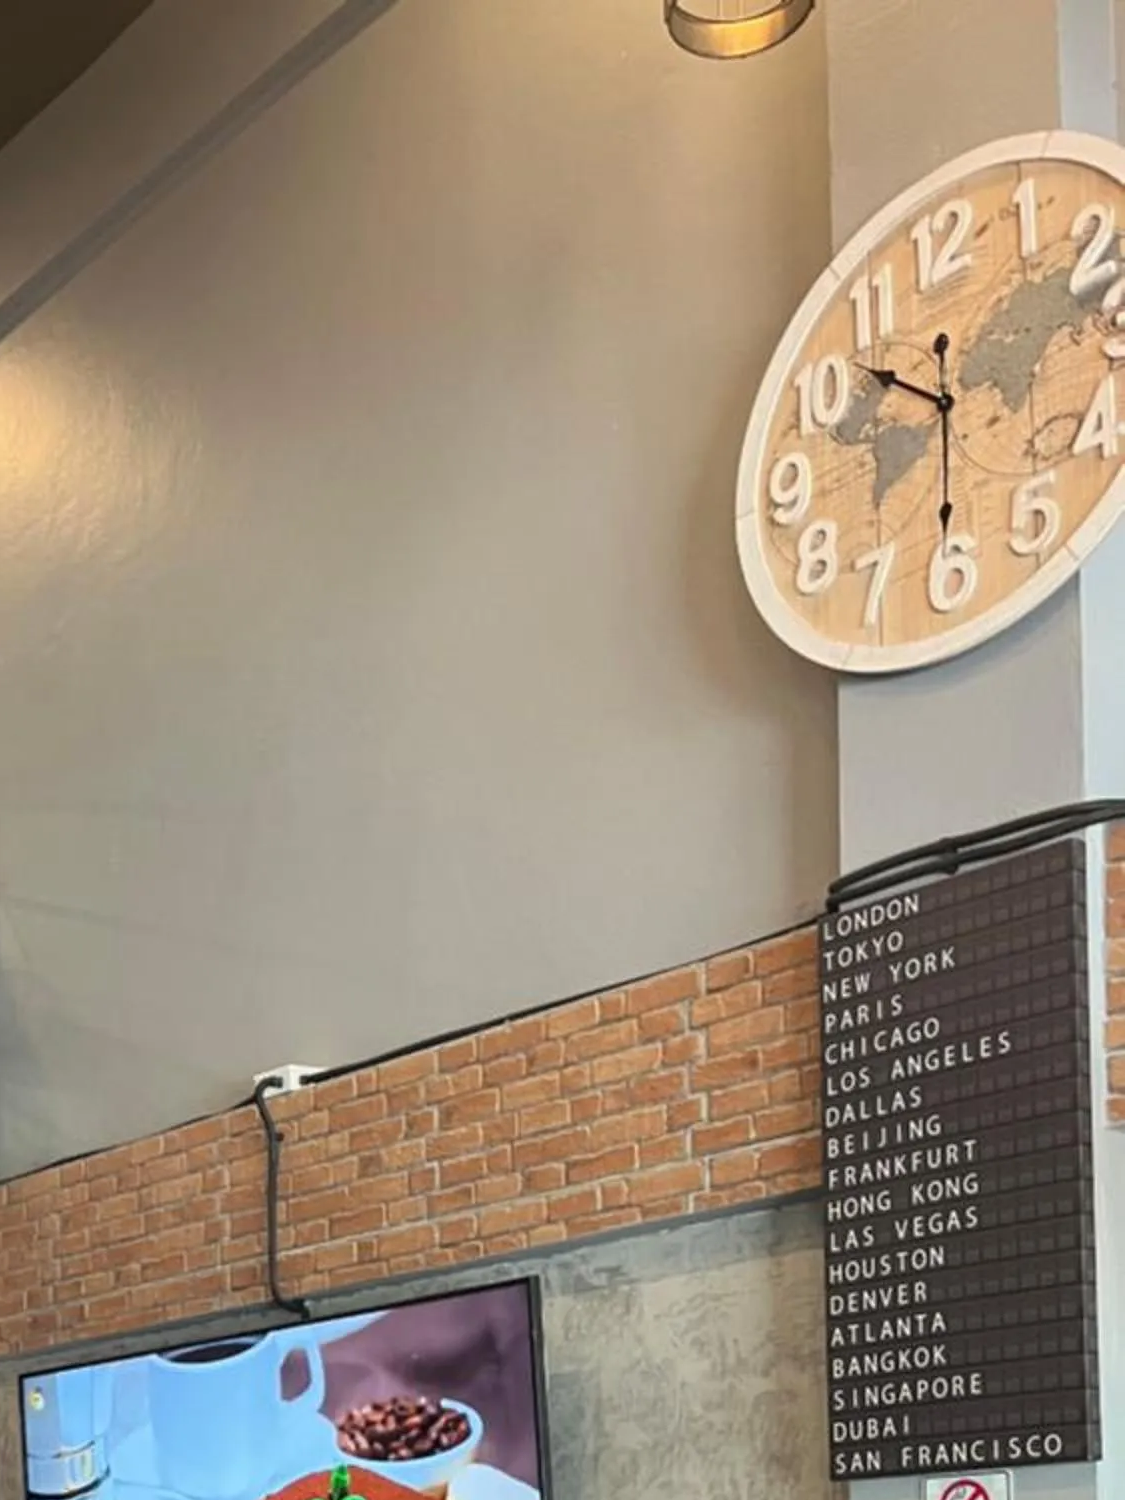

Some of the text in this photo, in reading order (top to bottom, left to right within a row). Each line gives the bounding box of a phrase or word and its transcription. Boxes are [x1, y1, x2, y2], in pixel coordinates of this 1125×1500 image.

[1012, 178, 1037, 258] 1
[911, 198, 974, 293] 12
[1069, 203, 1118, 295] 2
[850, 262, 893, 351] 11
[794, 354, 849, 437] 10
[1073, 374, 1125, 460] 4
[770, 452, 813, 527] 9
[1008, 470, 1061, 557] 5
[796, 518, 838, 595] 8
[928, 533, 979, 614] 6
[852, 541, 895, 629] 7
[824, 894, 920, 941] LONDON
[824, 931, 903, 971] TOKYO
[824, 946, 956, 1003] NEW YORK
[825, 994, 903, 1034] PARIS
[825, 1017, 940, 1065] CHICAGO
[827, 1031, 1011, 1097] LOS ANGELES
[825, 1087, 922, 1128] DALLAS
[827, 1114, 942, 1159] BEIJING
[828, 1140, 977, 1191] FRANKFURT
[827, 1173, 979, 1222] HONG KONG
[830, 1206, 978, 1252] LAS VEGAS
[829, 1246, 945, 1285] HOUSTON
[829, 1281, 927, 1316] DENVER
[831, 1312, 947, 1347] ATLANTA
[832, 1345, 947, 1379] BANGKOK
[834, 1373, 983, 1411] SINGAPORE
[833, 1415, 910, 1442] DUBAI
[834, 1433, 1063, 1474] SAN FRANCISCO
